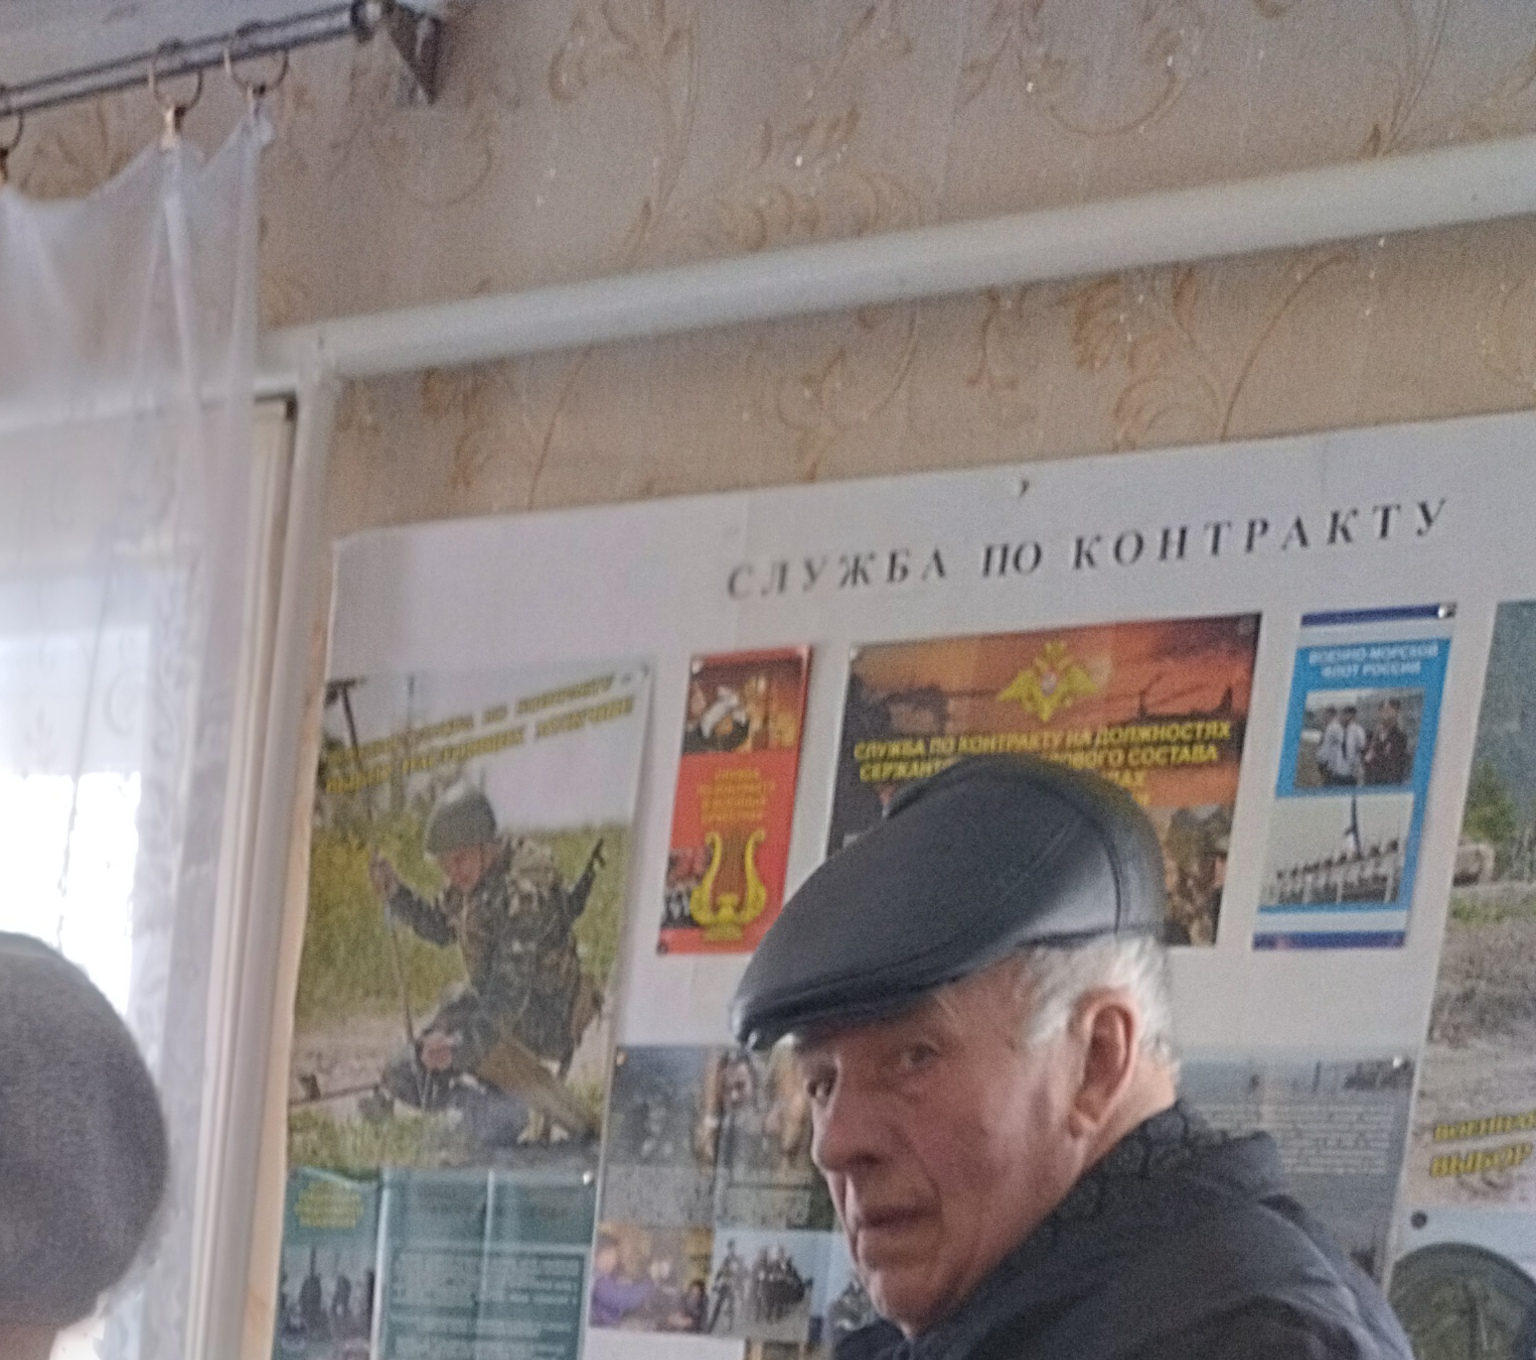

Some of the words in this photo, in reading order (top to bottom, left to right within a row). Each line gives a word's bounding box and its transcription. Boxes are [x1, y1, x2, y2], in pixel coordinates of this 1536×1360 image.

[727, 548, 948, 600] СЛУЖБА
[982, 541, 1042, 580] ПО
[1073, 498, 1451, 569] КОНТРАКТУ
[854, 738, 925, 762] СЛУЖБА
